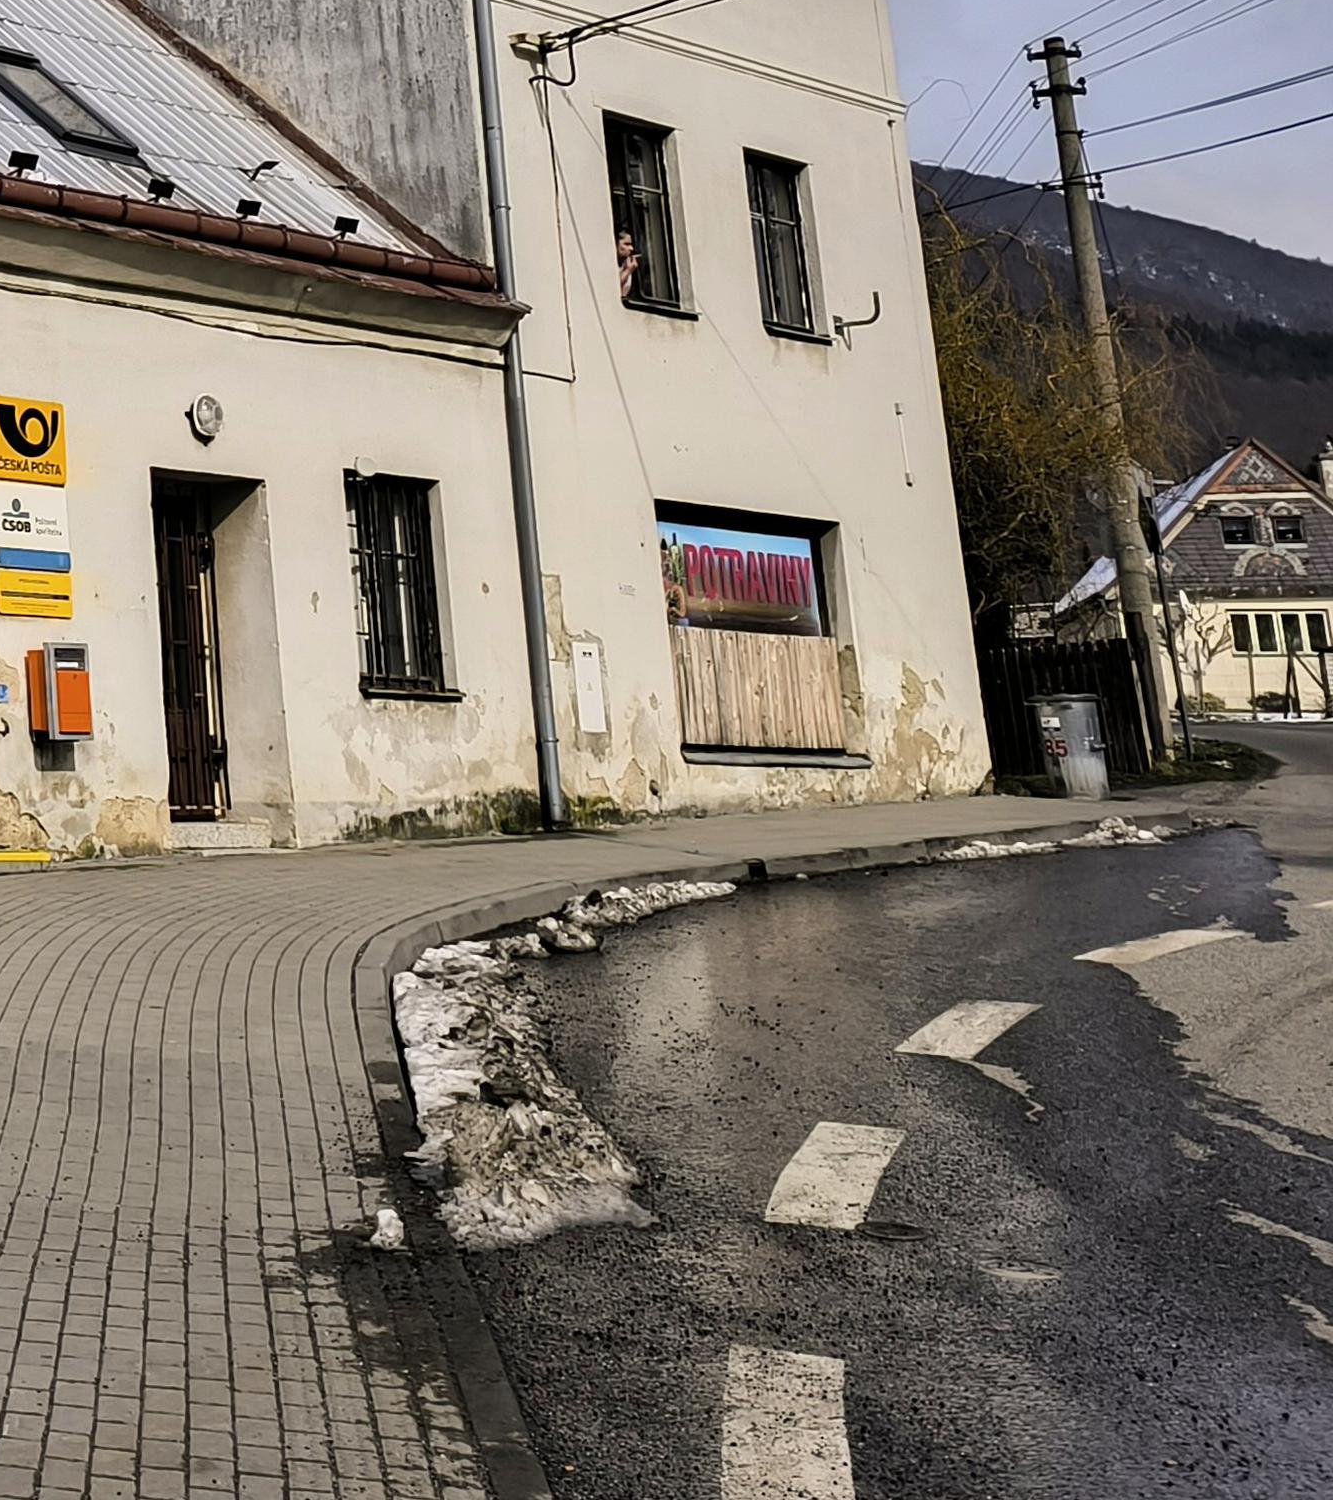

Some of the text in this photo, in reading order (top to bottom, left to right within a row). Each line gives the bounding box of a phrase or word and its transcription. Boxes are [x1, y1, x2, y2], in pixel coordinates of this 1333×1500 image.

[31, 461, 62, 476] POŠTA
[1, 518, 32, 533] ČSOB
[682, 542, 813, 608] POTRAVINY
[1045, 738, 1068, 758] 85
